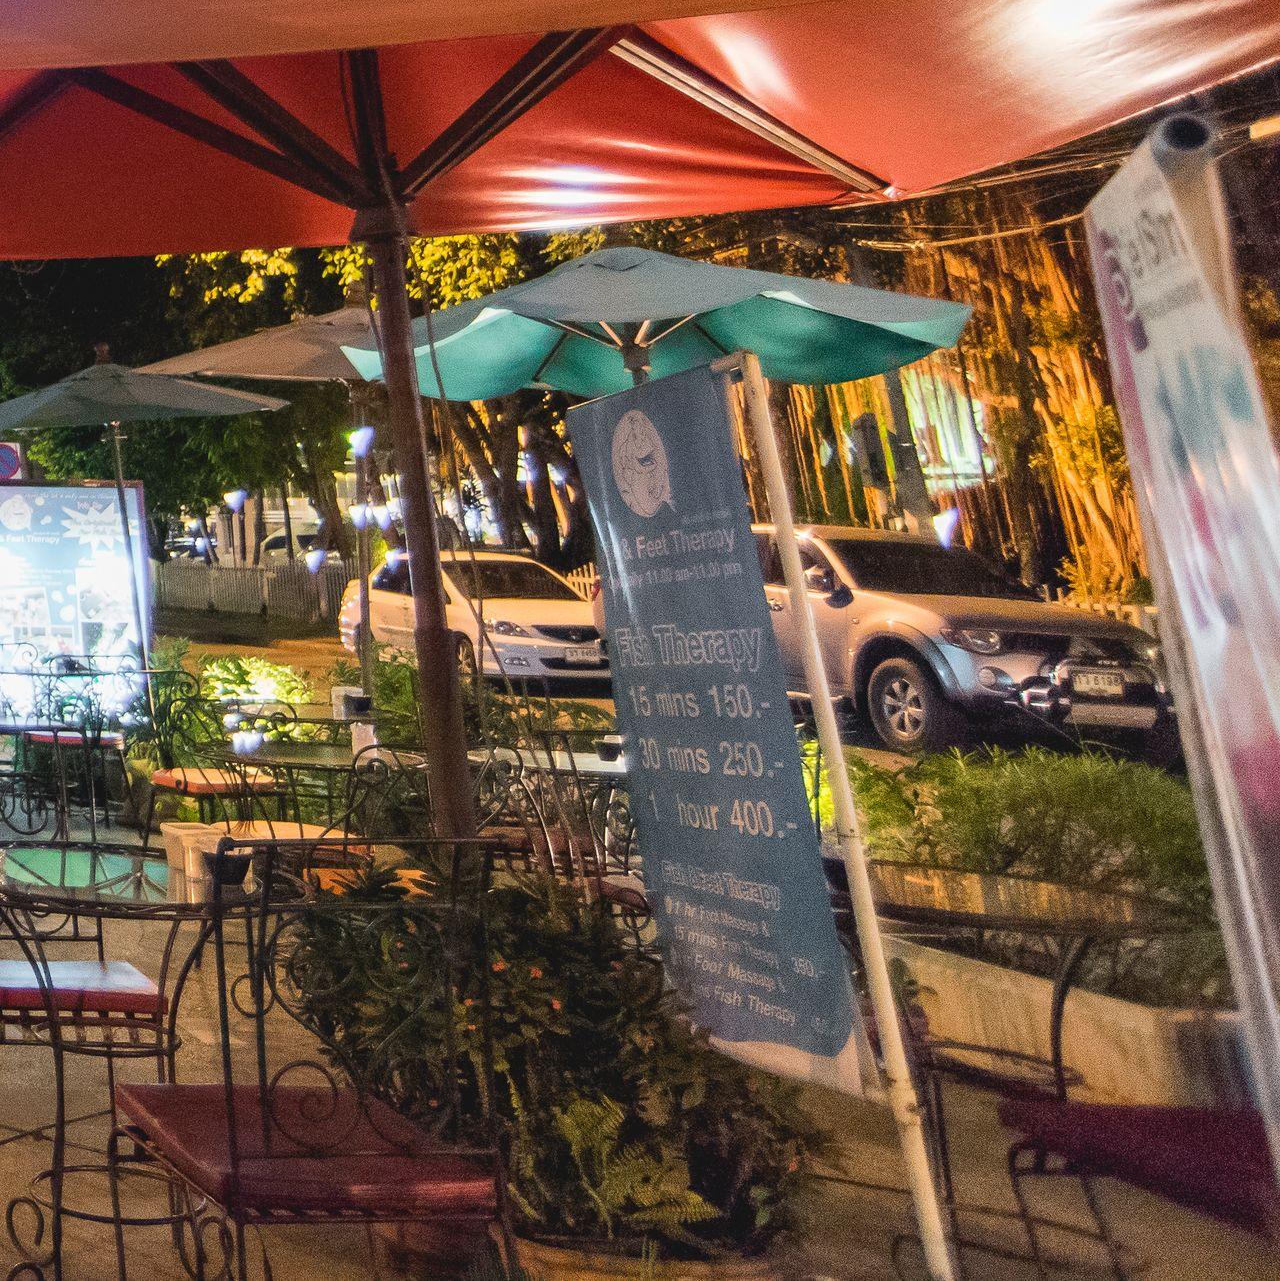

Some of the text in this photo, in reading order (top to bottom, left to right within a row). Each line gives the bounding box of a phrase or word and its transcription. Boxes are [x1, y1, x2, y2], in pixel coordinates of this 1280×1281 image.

[26, 534, 60, 545] Therapy
[635, 533, 670, 559] Feet
[670, 527, 736, 554] Therapy
[652, 623, 762, 672] Therapy
[629, 685, 652, 717] 15
[656, 687, 700, 718] mins
[667, 740, 711, 774] mins
[648, 789, 661, 821] 1
[675, 793, 720, 831] hour
